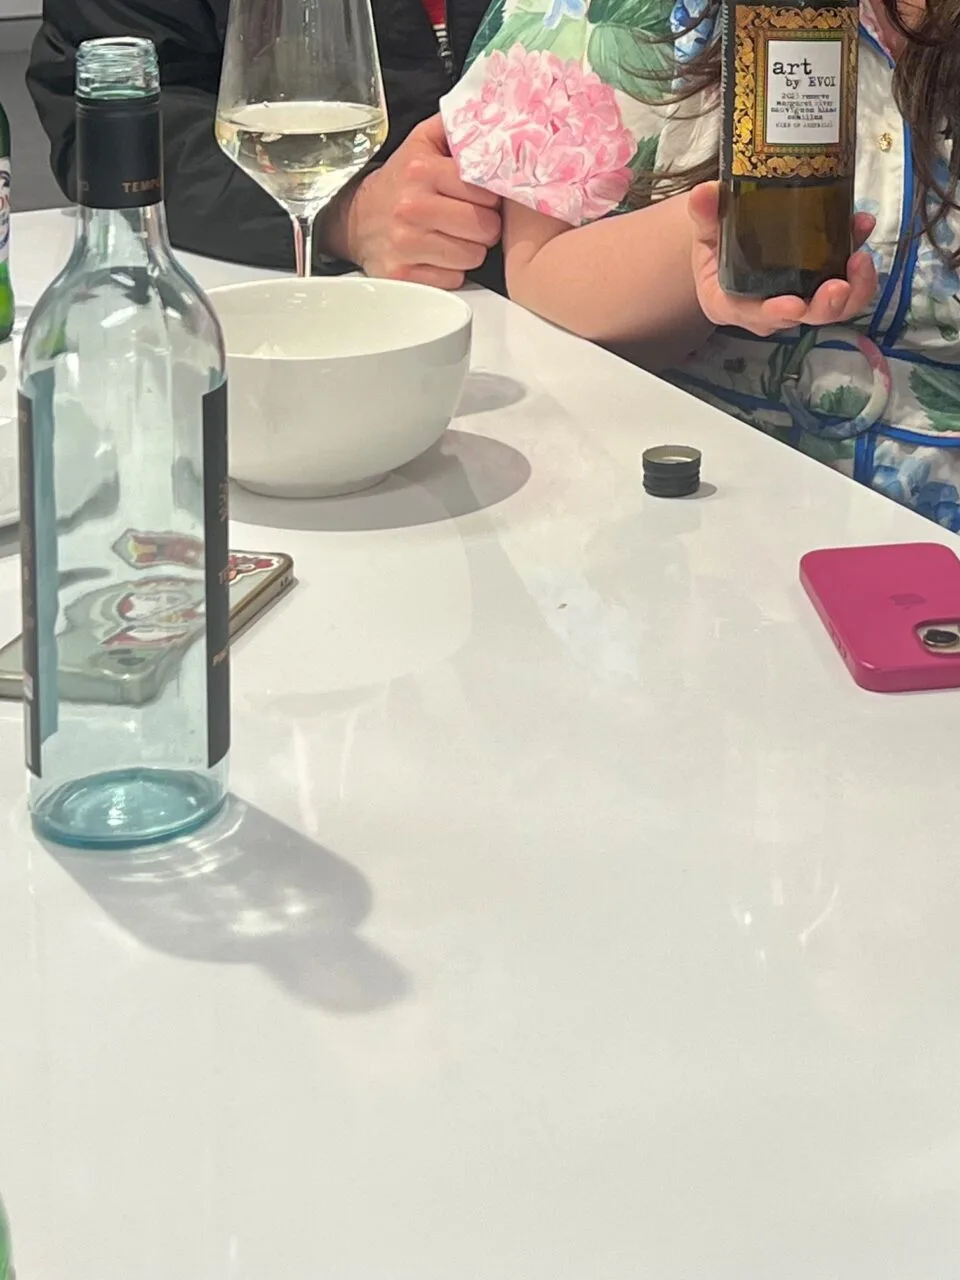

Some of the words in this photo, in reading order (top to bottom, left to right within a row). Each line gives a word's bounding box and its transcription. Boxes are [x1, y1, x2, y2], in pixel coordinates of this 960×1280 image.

[772, 58, 813, 76] art
[785, 75, 801, 90] by
[807, 76, 837, 88] EVOI
